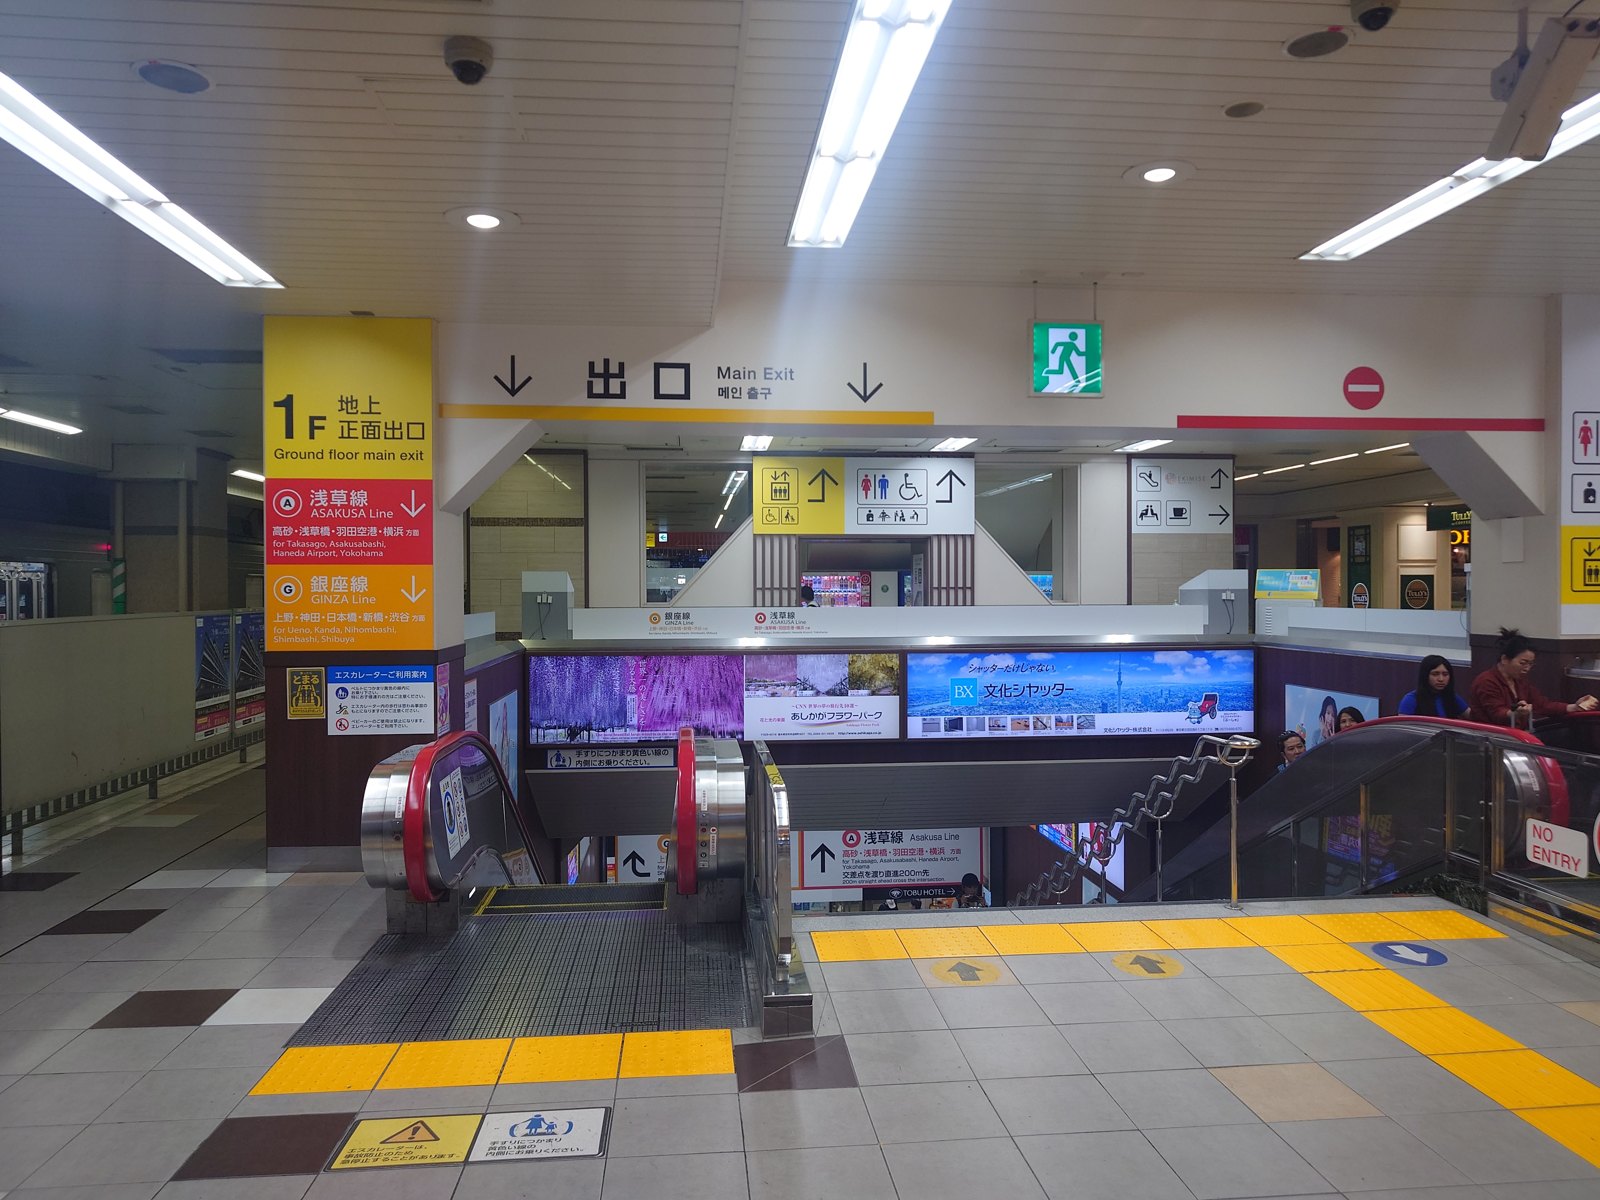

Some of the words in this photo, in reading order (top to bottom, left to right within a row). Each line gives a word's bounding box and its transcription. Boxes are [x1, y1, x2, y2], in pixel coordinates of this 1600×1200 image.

[717, 366, 757, 380] Main
[763, 367, 794, 381] Exit
[587, 358, 690, 400] 出口
[718, 386, 742, 399] 메인
[746, 387, 772, 399] 출구
[338, 395, 382, 415] 地上
[338, 420, 425, 440] 正面出口
[274, 448, 324, 460] Ground
[329, 449, 359, 460] floor
[363, 450, 396, 461] main
[400, 450, 424, 461] exit
[283, 498, 292, 508] A
[310, 489, 368, 507] 浅草線
[311, 508, 367, 519] ASAKUSA
[369, 508, 394, 519] Line
[272, 526, 404, 537] 高砂・浅草橋・羽田空港・横浜
[273, 540, 285, 548] for
[287, 540, 328, 549] Takasago,
[329, 540, 387, 549] Asakusabashi,
[306, 550, 338, 559] Airport,
[284, 584, 293, 594] G
[310, 576, 369, 593] 銀座線
[311, 595, 349, 605] GINZA
[352, 595, 376, 605] Line
[273, 612, 410, 623] 上野・神田・日本橋・新橋・渋谷
[770, 611, 796, 619] 浅草線
[273, 626, 286, 634] for
[287, 626, 312, 635] Ueno,
[314, 626, 343, 635] Kanda,
[344, 626, 397, 635] Nihombashi,
[273, 636, 320, 644] Shimbashi,
[321, 636, 355, 645] Shibuya
[293, 674, 320, 685] とまる
[335, 671, 427, 679] エスカレーターご利用案内
[954, 685, 974, 698] BX
[790, 711, 883, 721] あしかがフラワーパーク
[575, 749, 669, 757] 手すりにつかまり黄色い線の
[575, 759, 651, 767] 内側にお乗りください。
[863, 831, 904, 845] 浅草線
[910, 833, 943, 842] Asakusa
[944, 832, 960, 841] Line
[1532, 823, 1554, 843] NO
[1532, 844, 1582, 873] ENTRY
[842, 869, 930, 879] 交差点を渡り直進200m先
[903, 889, 922, 897] TOBU
[924, 888, 945, 896] HOTEL
[490, 1137, 562, 1146] 手すりにつかまり
[344, 1150, 414, 1159] 事故防止のため
[485, 1147, 584, 1157] 内側にお乗りください。
[340, 1153, 461, 1165] 急停止することがあります。
